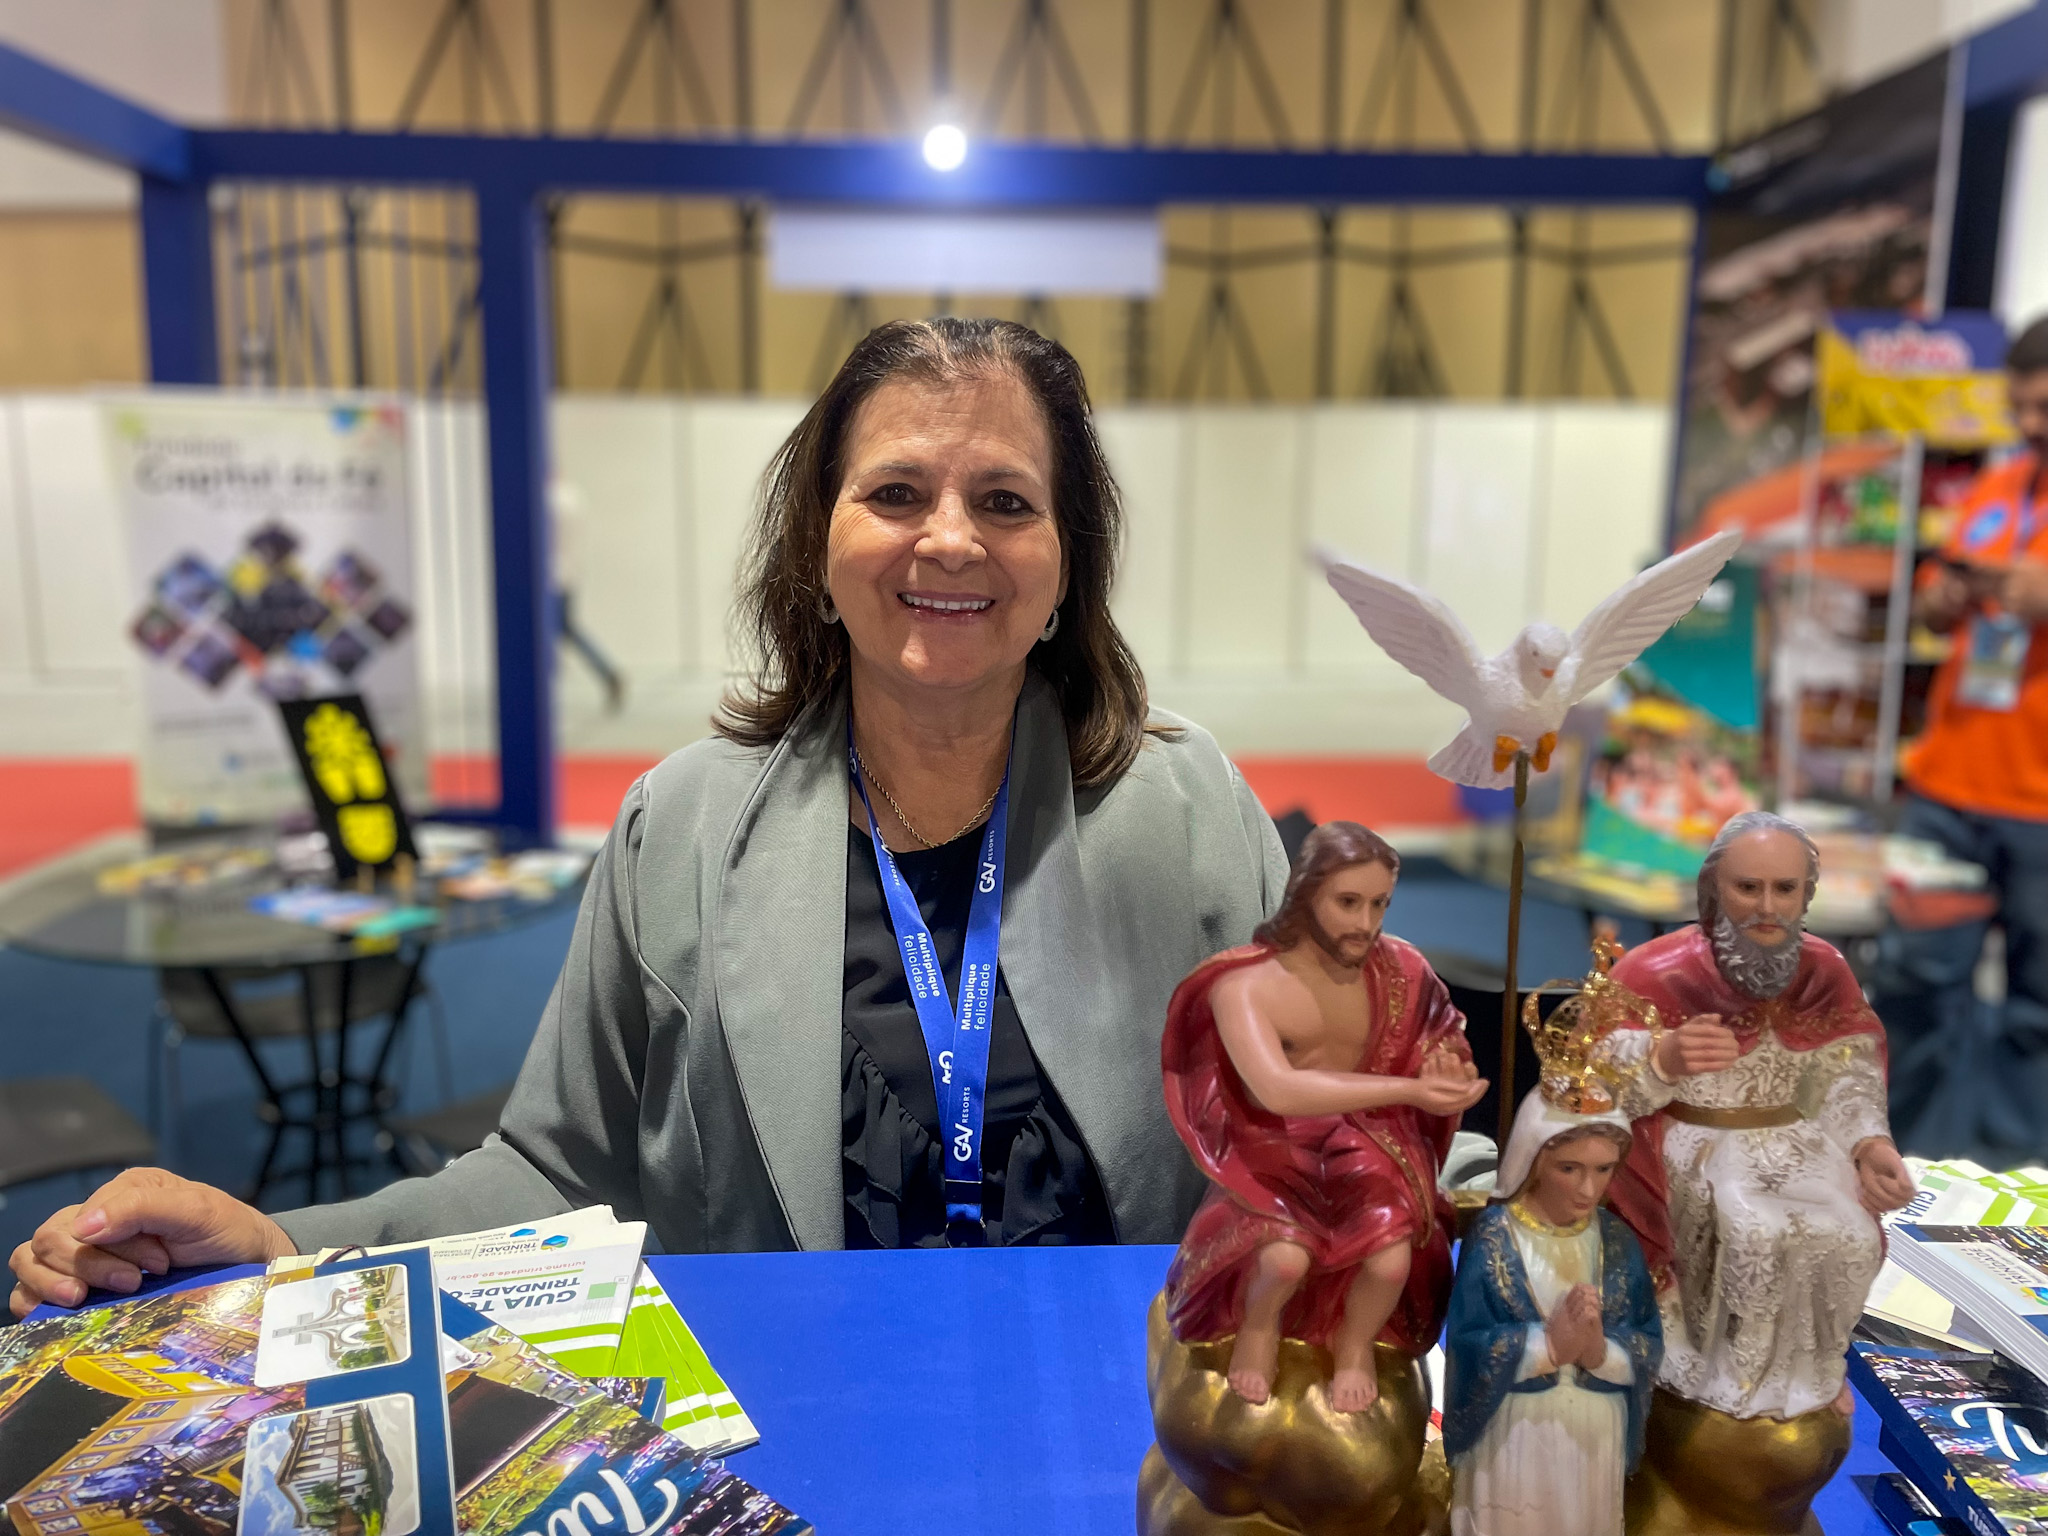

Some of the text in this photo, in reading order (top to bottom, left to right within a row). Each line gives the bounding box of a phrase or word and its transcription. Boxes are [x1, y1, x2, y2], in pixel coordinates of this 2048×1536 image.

[979, 862, 997, 893] GAV
[903, 934, 927, 999] felicidade
[917, 932, 940, 997] Multiplique
[961, 963, 977, 1030] Multiplique
[974, 963, 991, 1030] felicidade
[953, 1087, 974, 1162] GAV RESORTS
[446, 1260, 587, 1281] turismo.trindade.go.gov.br
[478, 1242, 537, 1254] TRINDADE
[504, 1290, 577, 1310] GUIA
